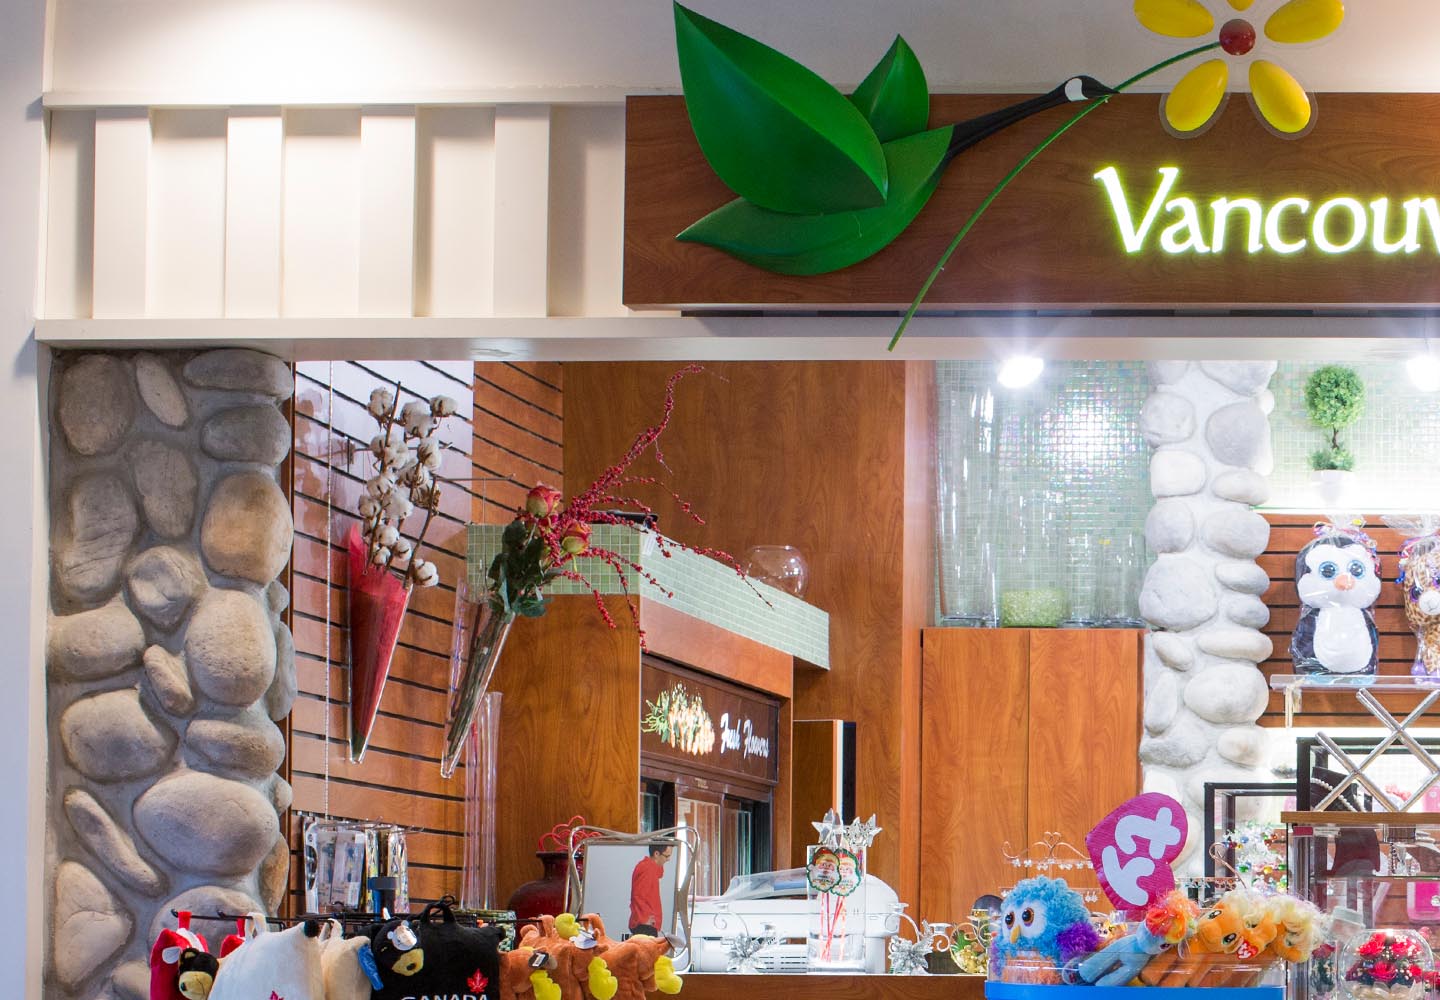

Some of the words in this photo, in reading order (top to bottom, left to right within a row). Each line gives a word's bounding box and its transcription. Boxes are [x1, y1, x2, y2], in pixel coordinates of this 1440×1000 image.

[720, 713, 741, 754] Fresh
[743, 719, 769, 760] Flowers
[1102, 807, 1182, 907] ty
